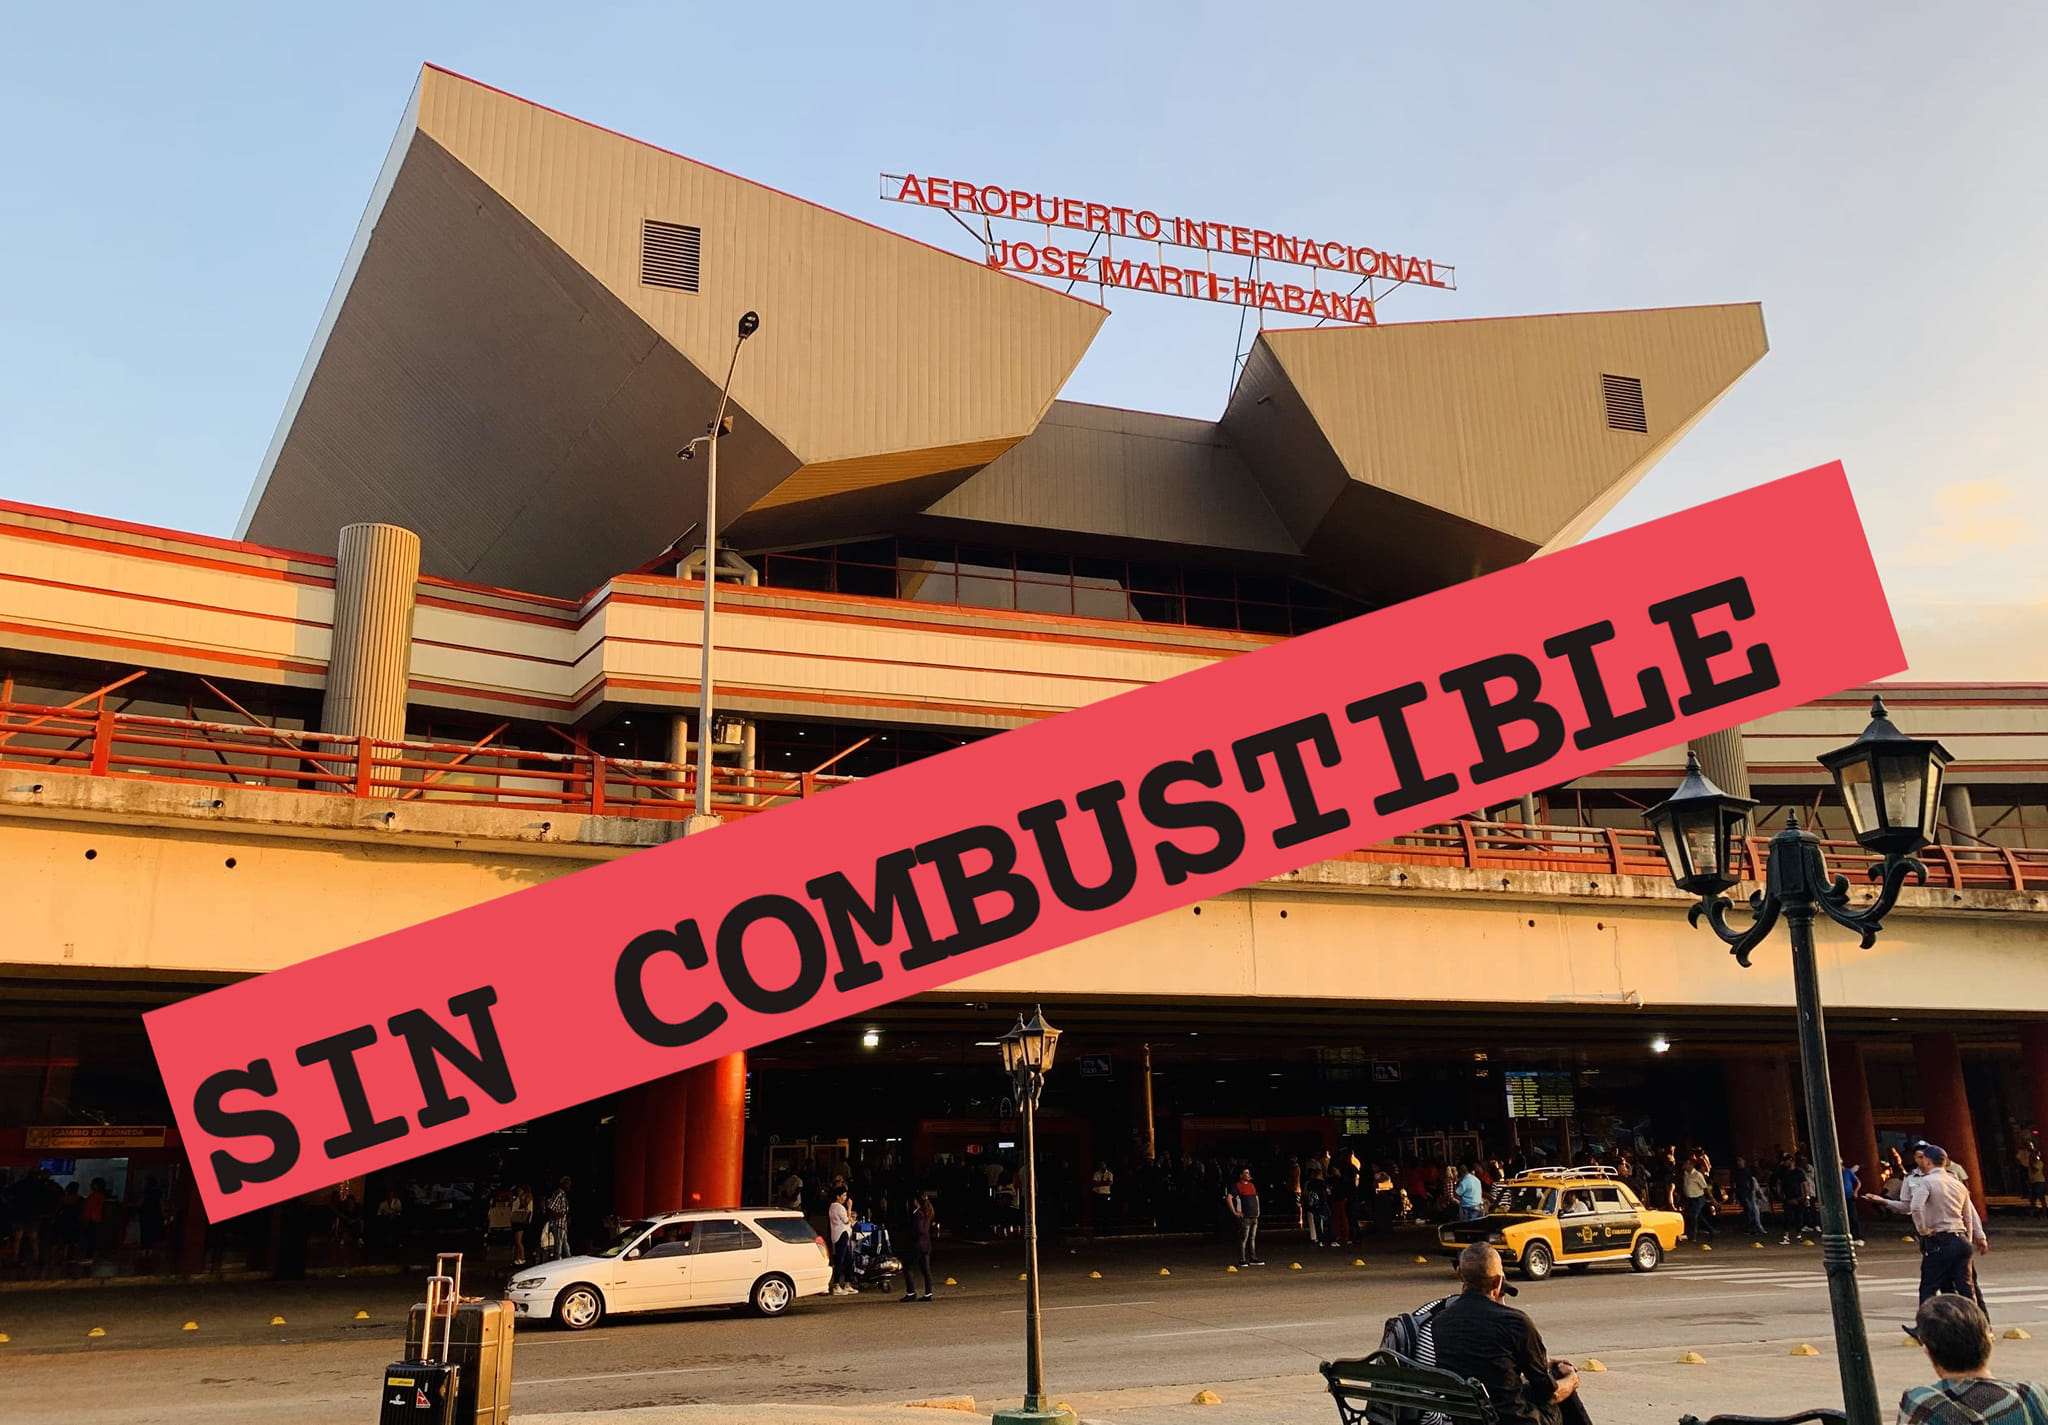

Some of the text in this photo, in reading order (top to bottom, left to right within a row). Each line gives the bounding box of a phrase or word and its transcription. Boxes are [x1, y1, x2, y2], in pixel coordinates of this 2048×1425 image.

[898, 173, 1447, 288] AEROPUERTO INTERNACIONAL
[989, 239, 1090, 282] JOSE
